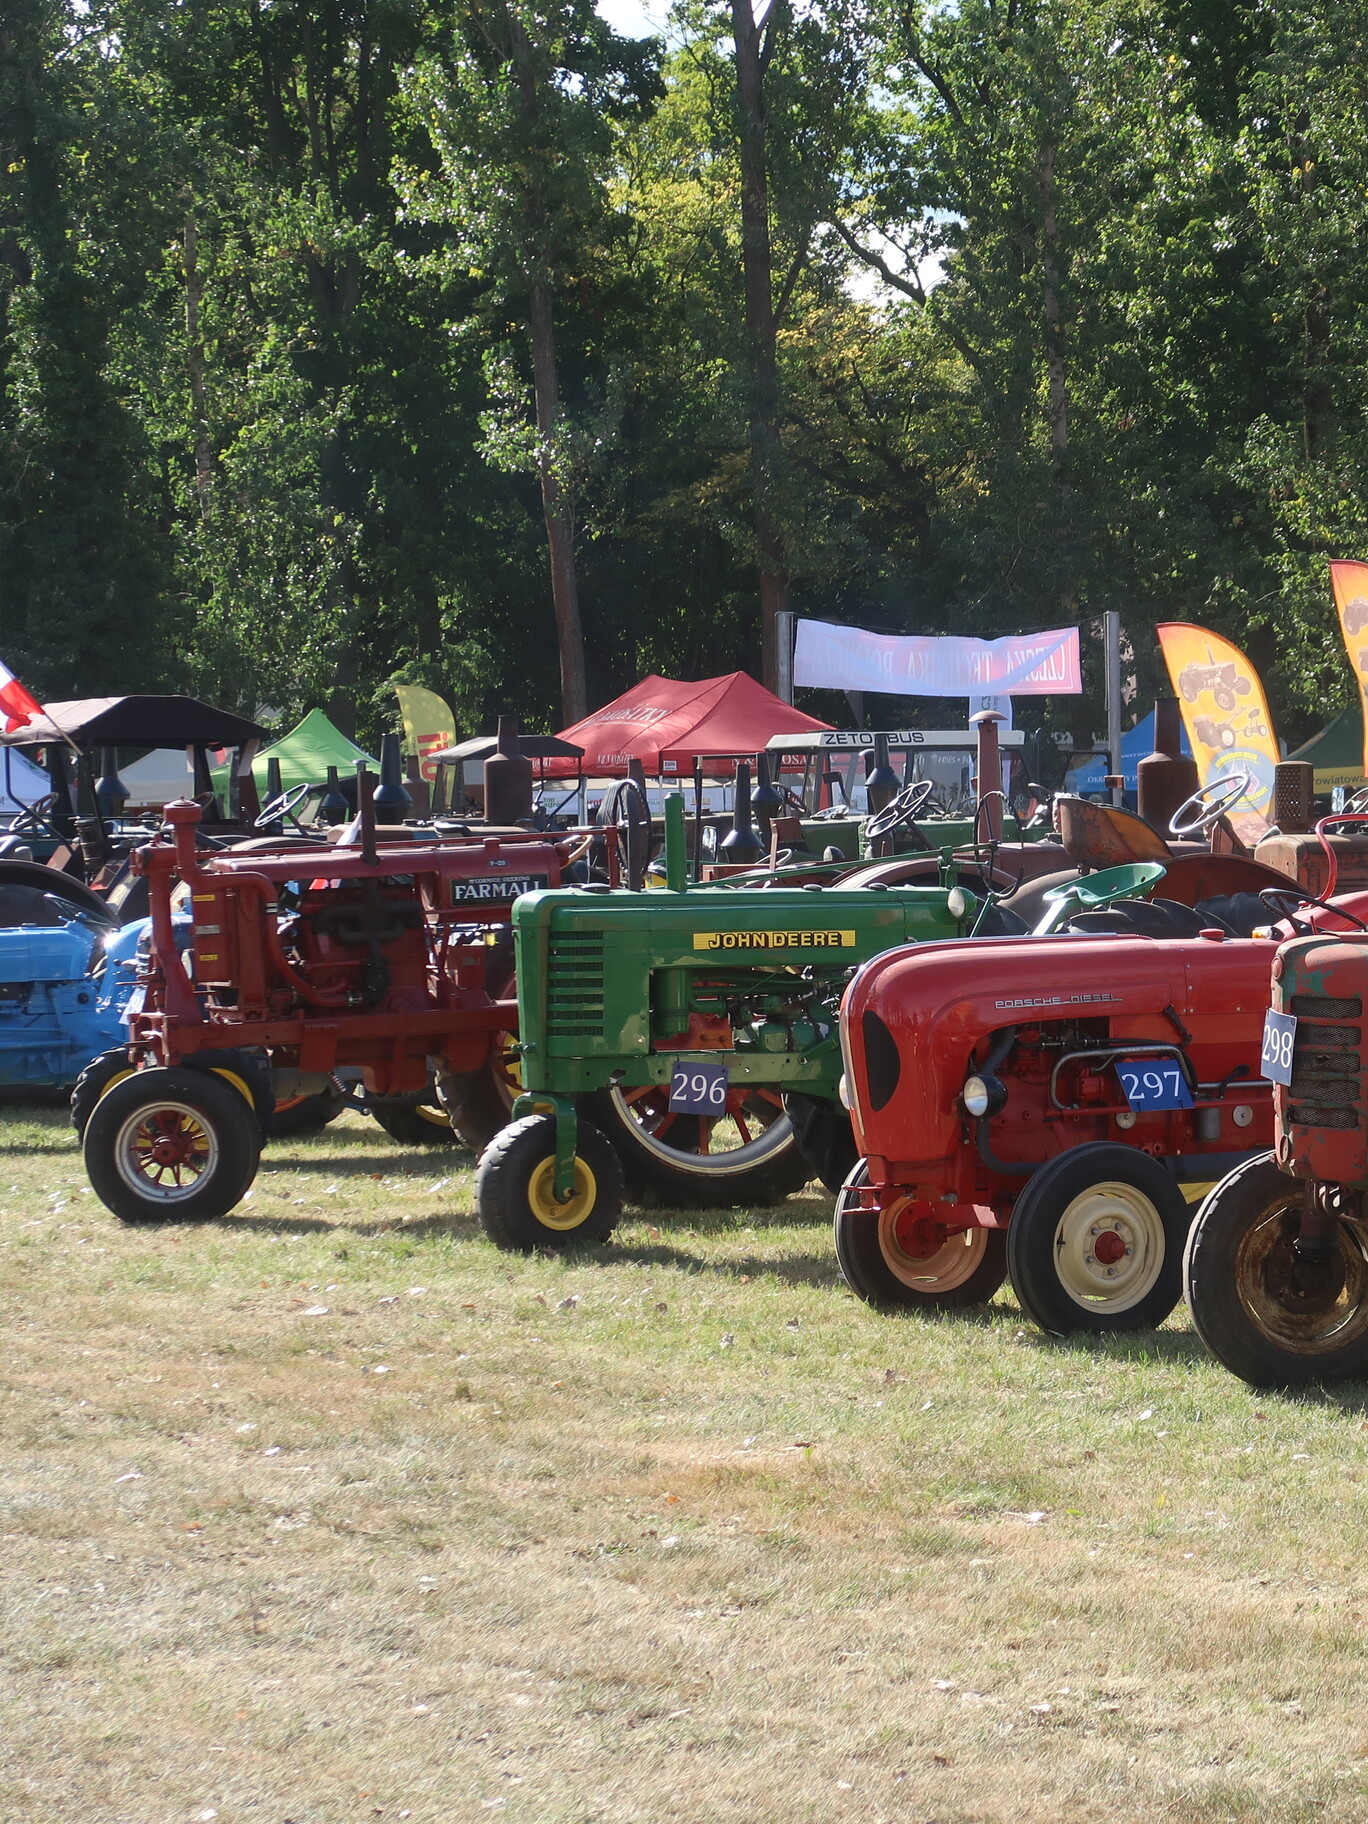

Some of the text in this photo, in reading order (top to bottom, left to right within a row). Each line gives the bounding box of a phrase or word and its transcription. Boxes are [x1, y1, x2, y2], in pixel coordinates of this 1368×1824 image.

[1314, 775, 1366, 785] owiatowa
[709, 931, 842, 949] JOHN DEERE
[1069, 993, 1123, 1005] DIESEL
[1262, 1022, 1292, 1070] 298
[670, 1071, 726, 1104] 296
[1121, 1070, 1182, 1099] 297
